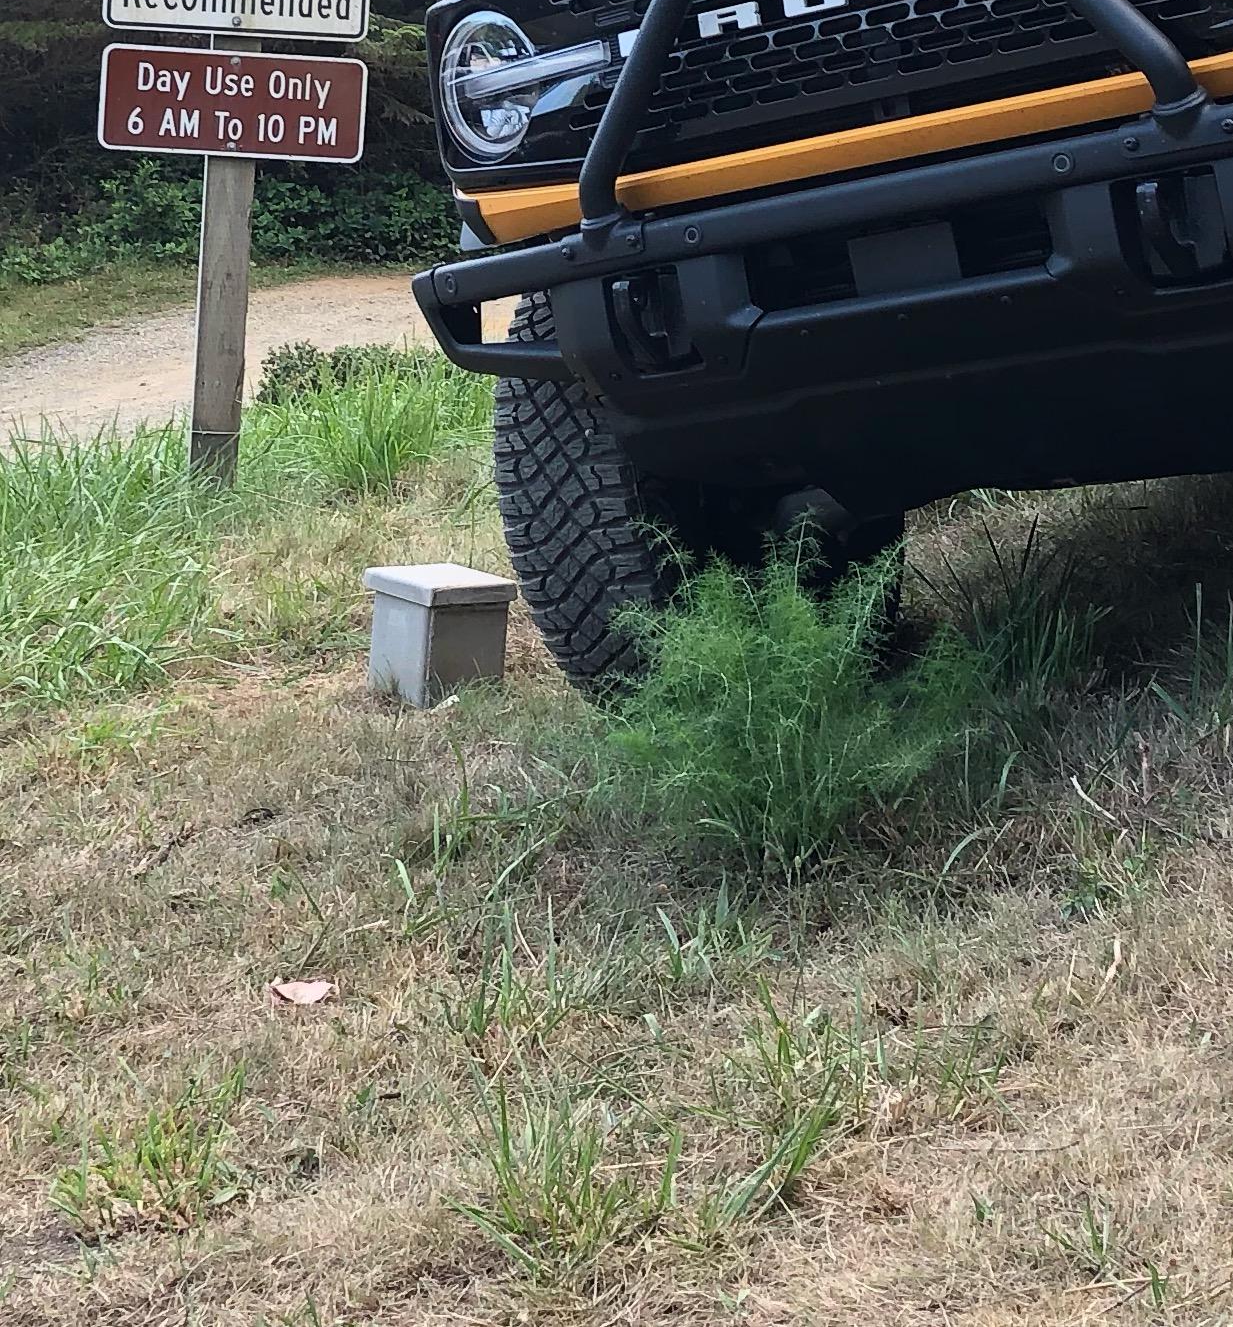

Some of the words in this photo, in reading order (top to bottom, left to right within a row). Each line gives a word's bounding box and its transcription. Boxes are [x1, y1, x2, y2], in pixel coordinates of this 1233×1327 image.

[137, 61, 191, 101] Day
[205, 65, 255, 97] Use
[268, 70, 331, 110] Only
[127, 106, 144, 136] 6
[158, 107, 200, 139] AM
[214, 110, 243, 141] To
[257, 113, 285, 144] 10
[298, 115, 338, 147] PM
